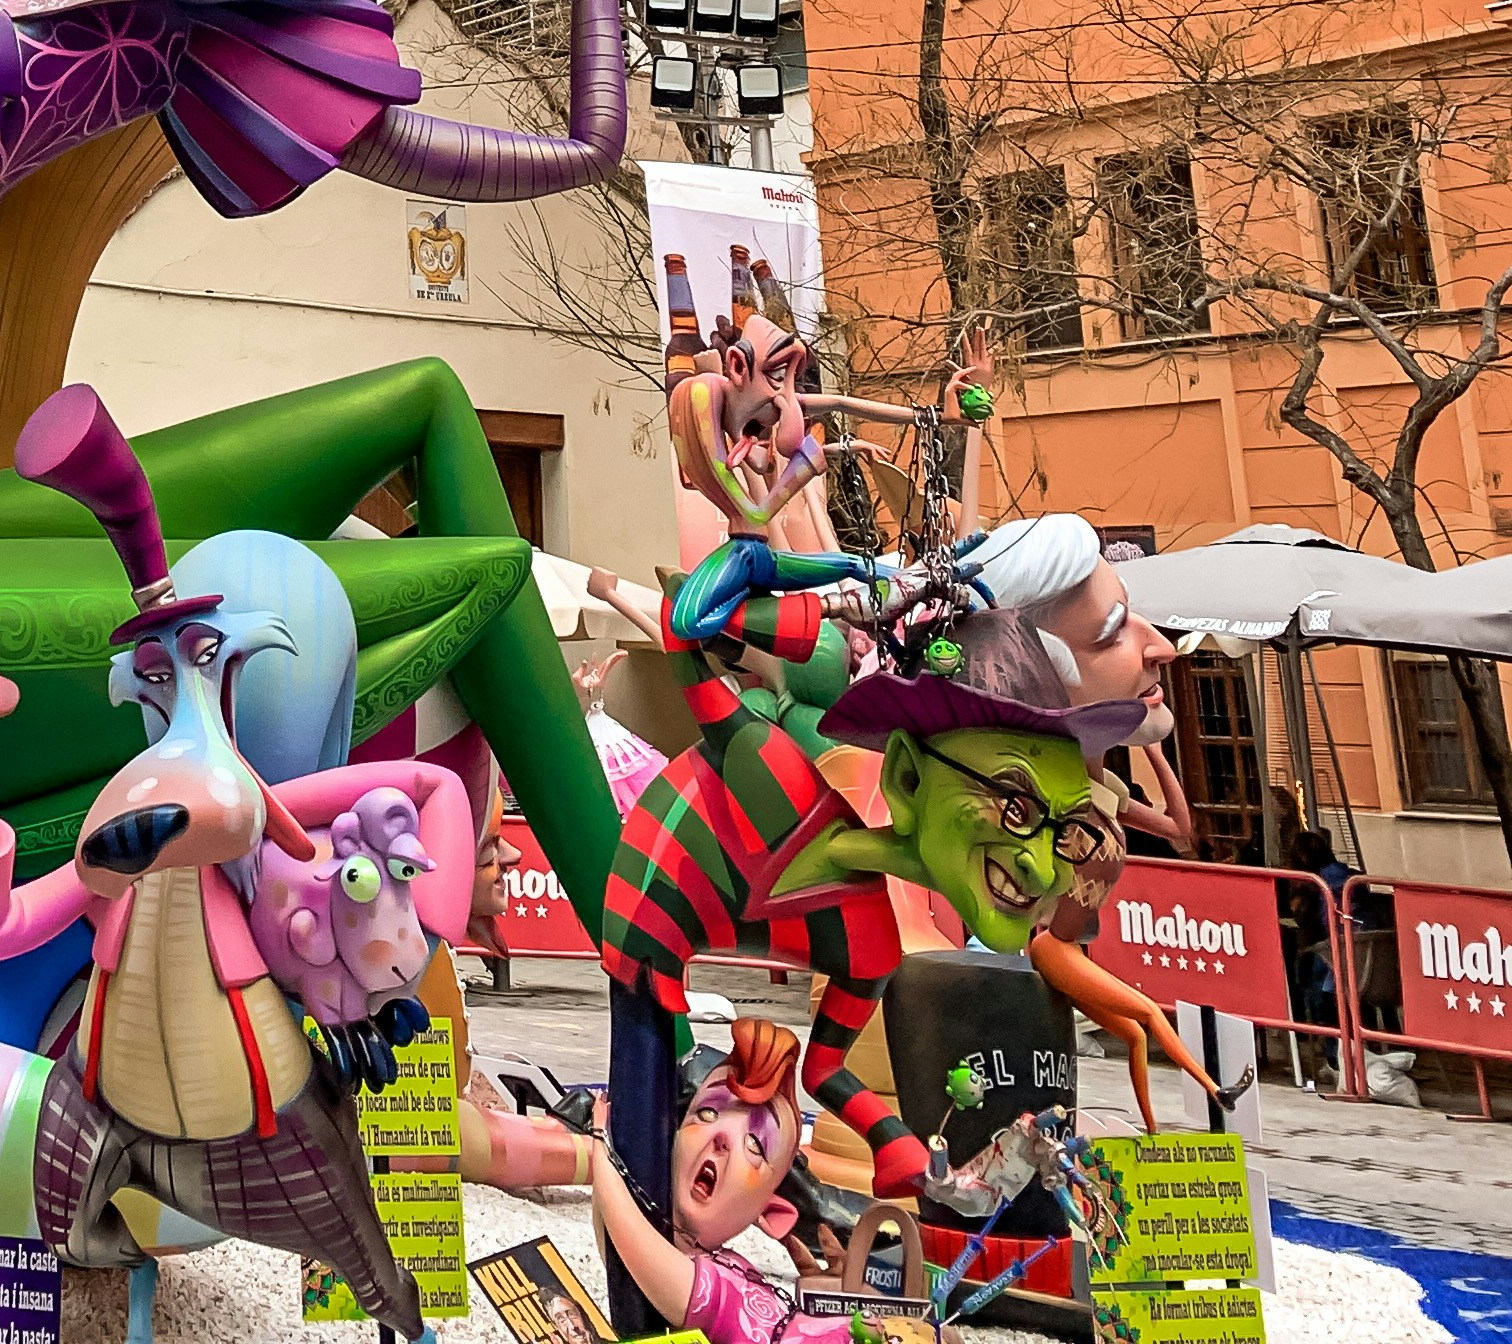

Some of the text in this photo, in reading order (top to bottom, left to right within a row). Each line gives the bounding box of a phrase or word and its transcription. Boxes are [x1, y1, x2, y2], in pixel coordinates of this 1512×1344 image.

[762, 187, 804, 204] Mahou
[1165, 614, 1230, 632] CERVEZAS
[1116, 899, 1248, 957] Mahou
[1415, 921, 1512, 987] Mah
[418, 1056, 429, 1078] de
[430, 1056, 451, 1085] gurú
[965, 1050, 1015, 1091] EL
[389, 1090, 409, 1112] molt
[410, 1090, 422, 1112] be
[423, 1090, 436, 1112] els
[437, 1096, 453, 1112] ous
[420, 1123, 430, 1146] fa
[1173, 1140, 1185, 1163] als
[1175, 1218, 1190, 1242] per
[1196, 1211, 1211, 1234] les
[17, 1243, 28, 1270] la
[29, 1251, 59, 1273] casta
[473, 1255, 539, 1307] KILL
[11, 1282, 18, 1309] i
[18, 1283, 54, 1312] insana
[10, 1321, 20, 1344] la
